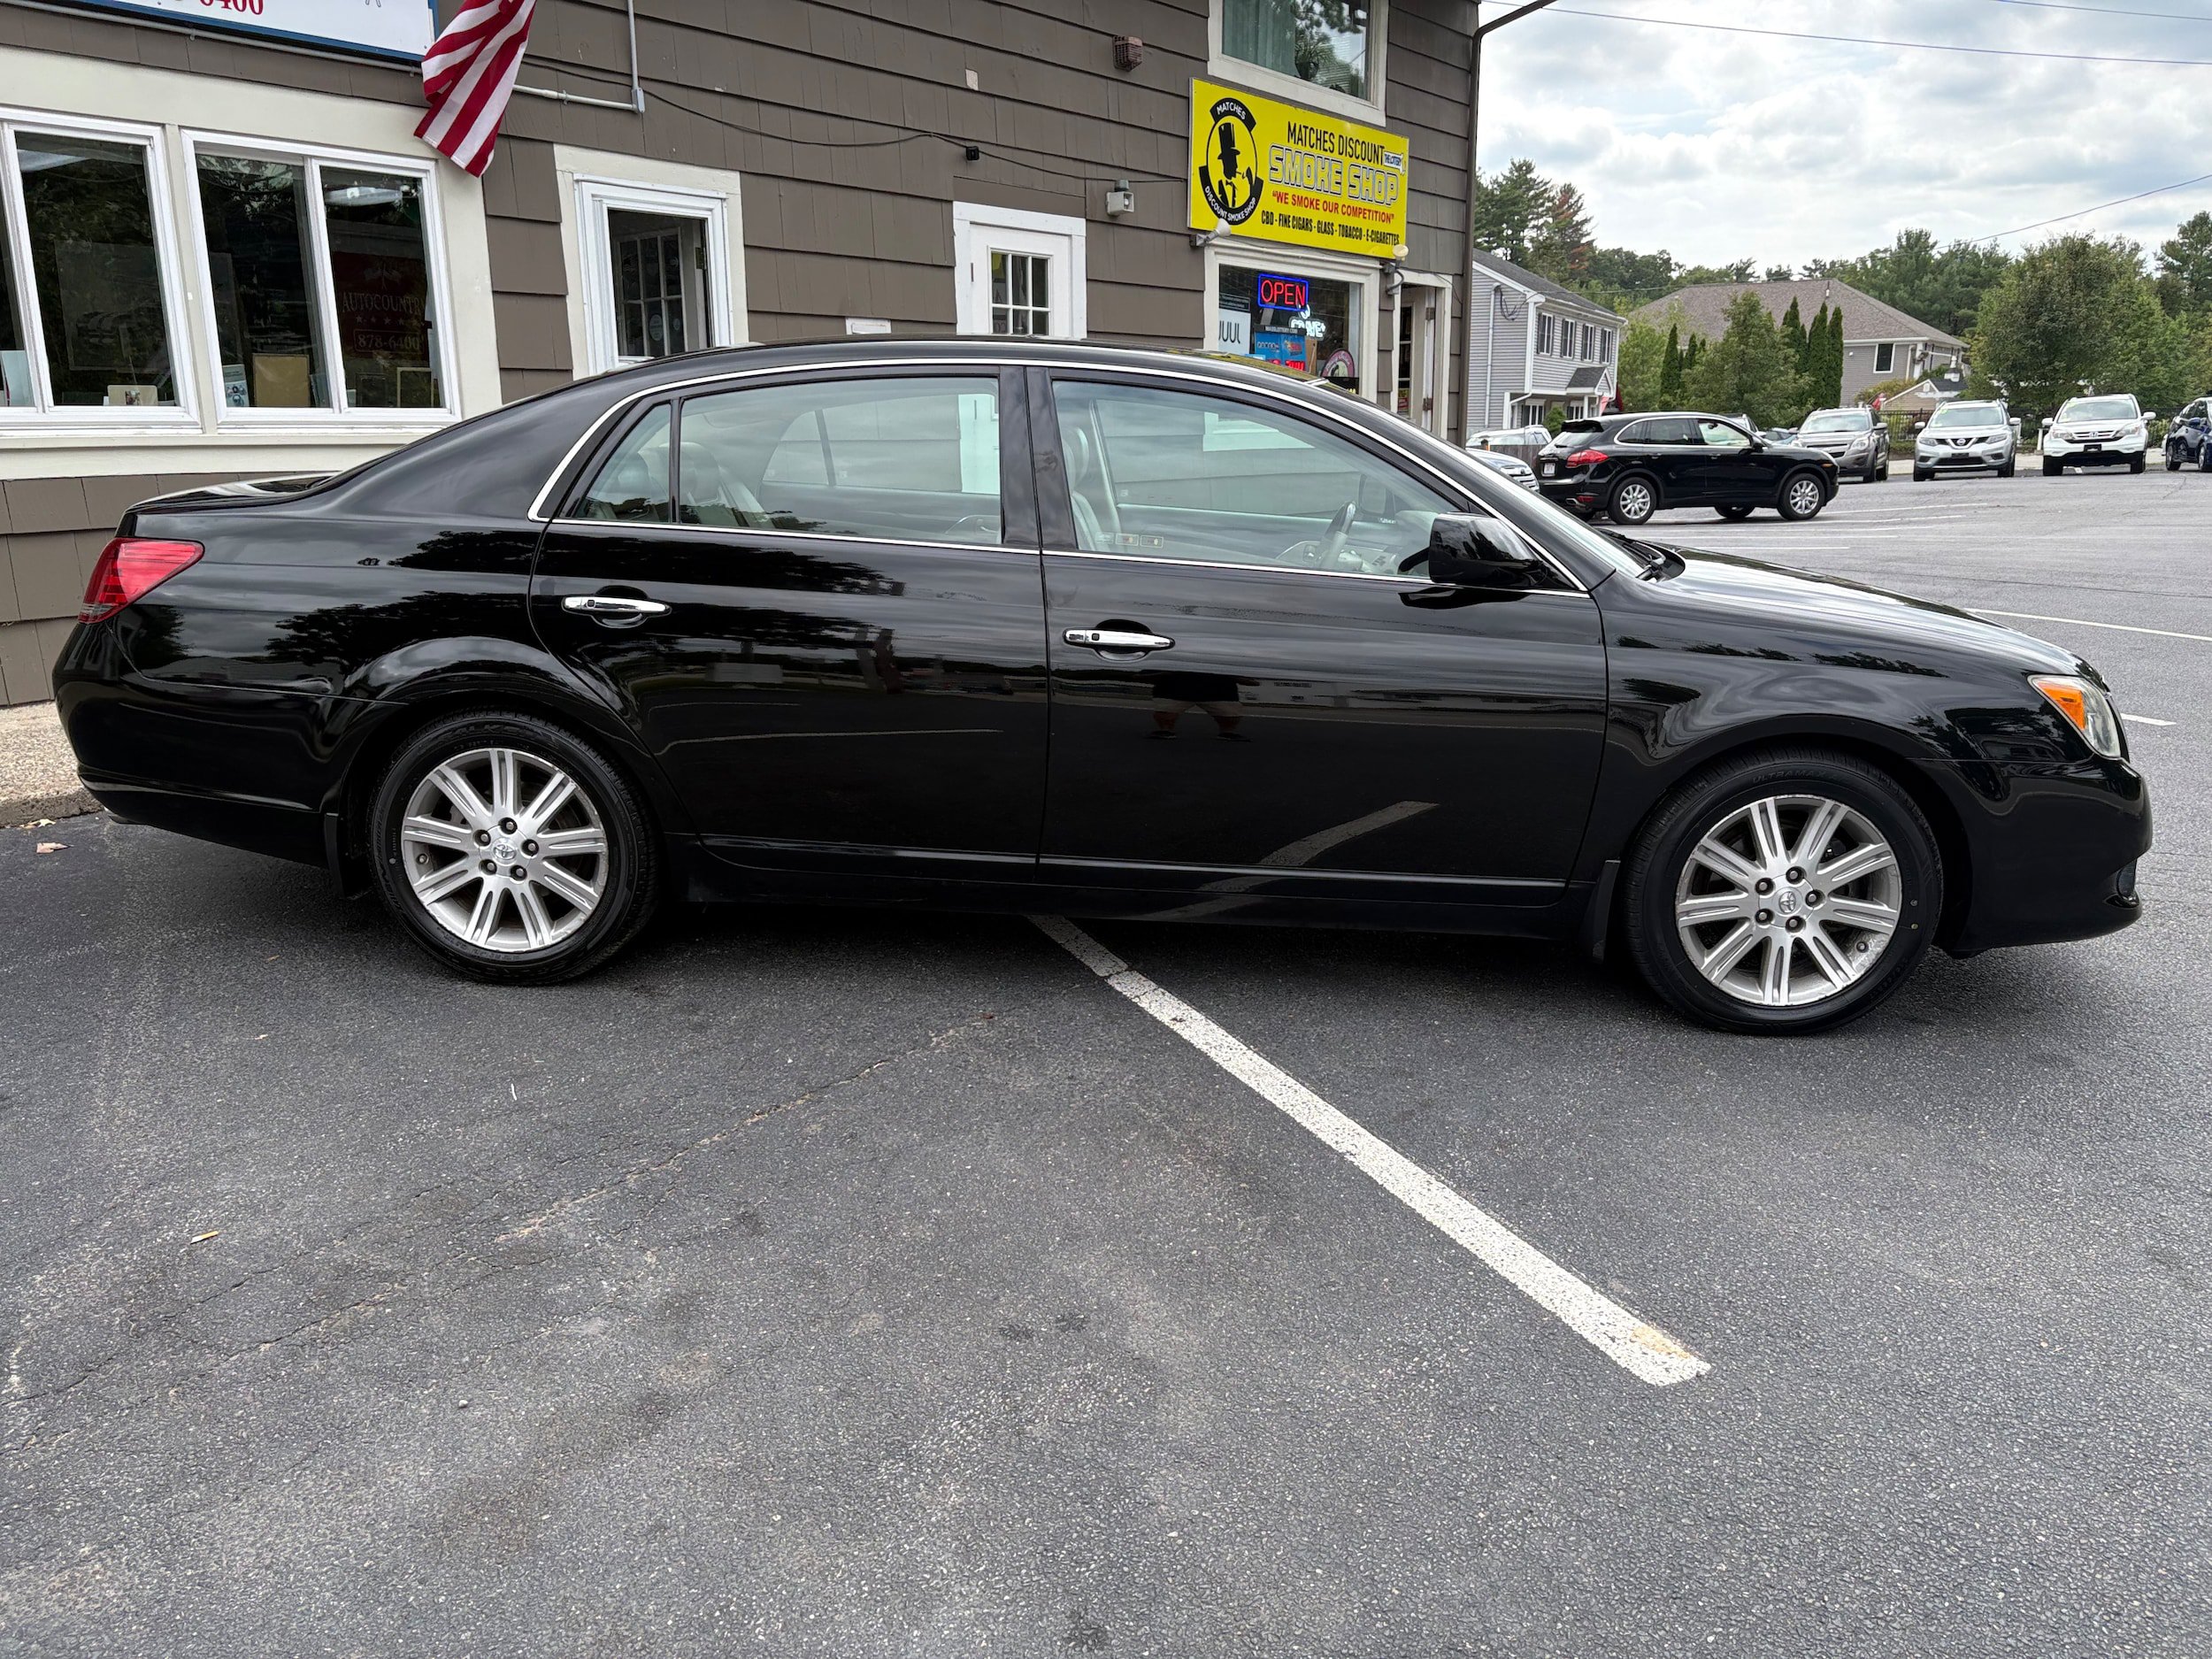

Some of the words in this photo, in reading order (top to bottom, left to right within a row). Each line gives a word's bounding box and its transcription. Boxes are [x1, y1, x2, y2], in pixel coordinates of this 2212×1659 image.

[200, 0, 264, 15] 00
[1217, 102, 1246, 120] MATCHES
[1287, 121, 1335, 154] MATCHES
[1338, 134, 1386, 165] DISCOUNT
[1269, 142, 1343, 197] SMOKE
[1348, 162, 1399, 208] SHOP
[1204, 185, 1228, 219] DISCOUNT
[1227, 211, 1246, 222] SMOKE
[1244, 196, 1256, 217] SHOP
[1291, 196, 1320, 211] SMOKE
[1322, 201, 1339, 215] OUR
[1261, 210, 1274, 226] CBD
[1279, 213, 1291, 228] FINE
[1292, 215, 1313, 232] CIGARS
[1317, 219, 1334, 236] GLASS
[1338, 224, 1363, 241] TOBACCO
[1366, 228, 1400, 246] E-CIGARETTES
[1261, 280, 1306, 306] OPEN
